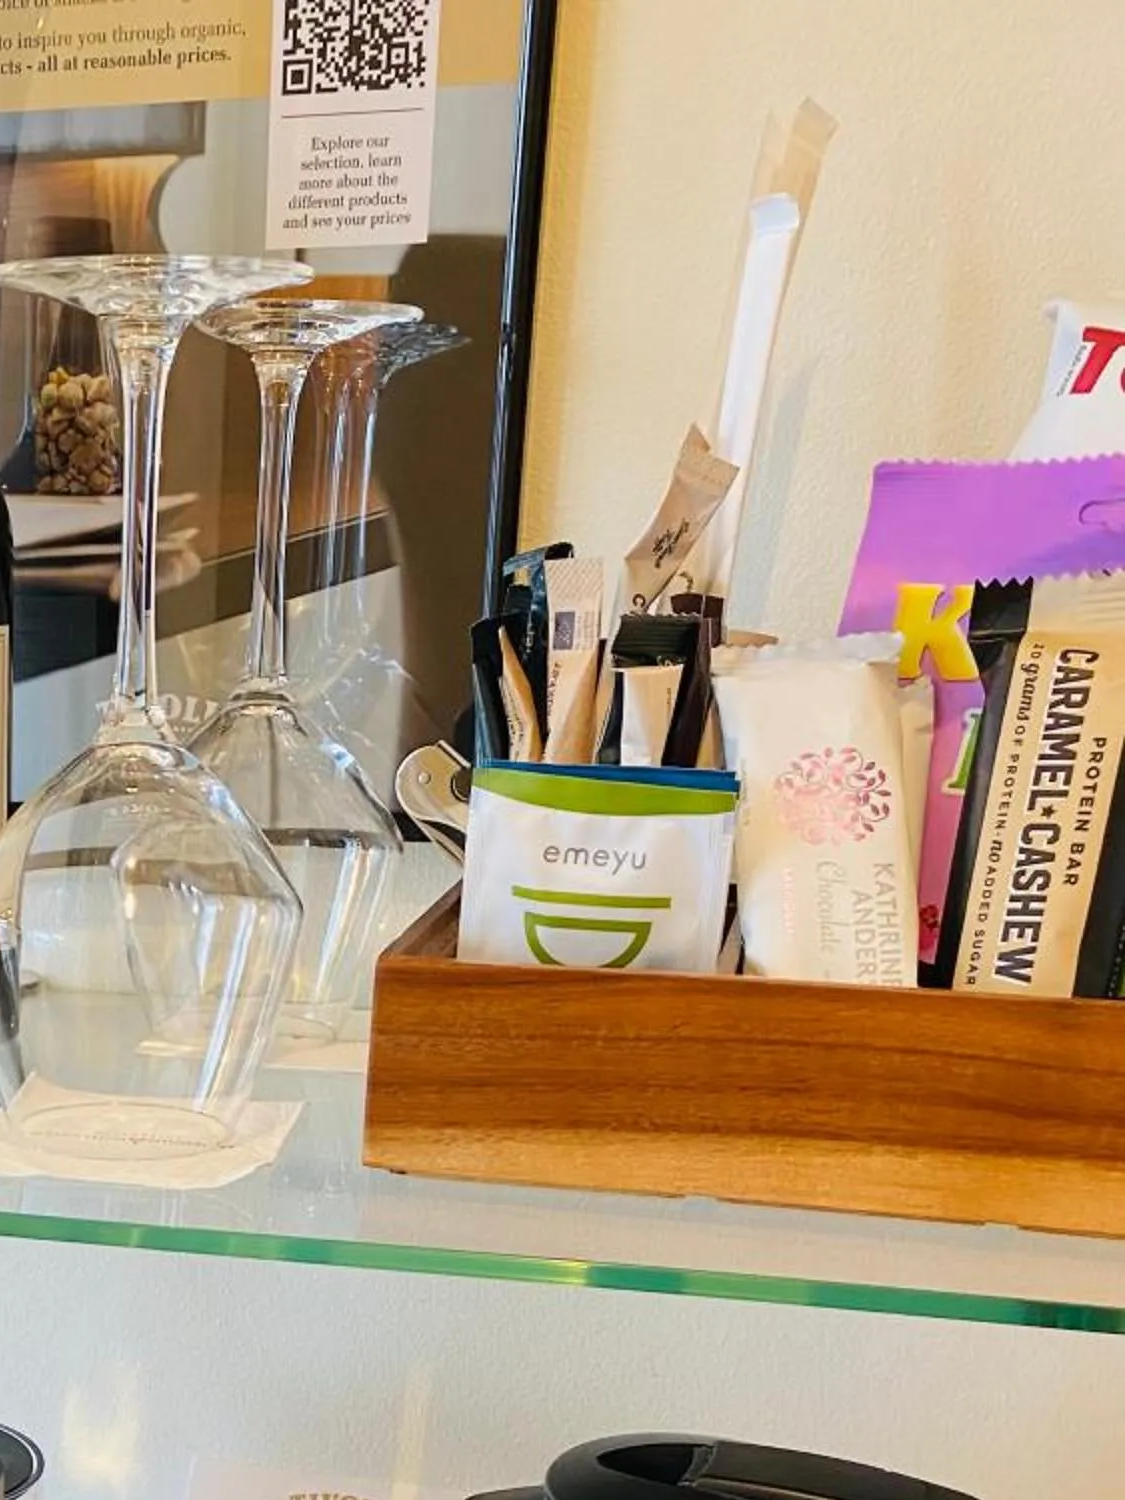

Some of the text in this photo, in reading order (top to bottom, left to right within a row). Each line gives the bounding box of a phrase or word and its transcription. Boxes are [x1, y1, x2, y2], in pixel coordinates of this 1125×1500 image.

[18, 31, 72, 52] inspire
[78, 31, 107, 50] you
[112, 21, 175, 46] through
[180, 18, 247, 42] organic,
[37, 54, 58, 72] all
[63, 55, 78, 71] at
[83, 48, 172, 71] reasonable
[176, 46, 232, 69] prices.
[311, 136, 390, 153] Explore our
[300, 153, 402, 171] selection, learn
[299, 172, 398, 190] more about the
[288, 192, 408, 211] different products
[283, 212, 411, 231] and see your prices
[1069, 326, 1125, 394] T
[1017, 662, 1041, 721] grams
[1014, 725, 1026, 747] OF
[994, 649, 1099, 984] CARAMEL CASHEW
[1063, 737, 1107, 886] PROTEIN BAR
[543, 845, 646, 875] emeyu
[976, 866, 997, 923] ADDED
[851, 889, 878, 983] ANDER
[966, 929, 985, 985] SUGAR
